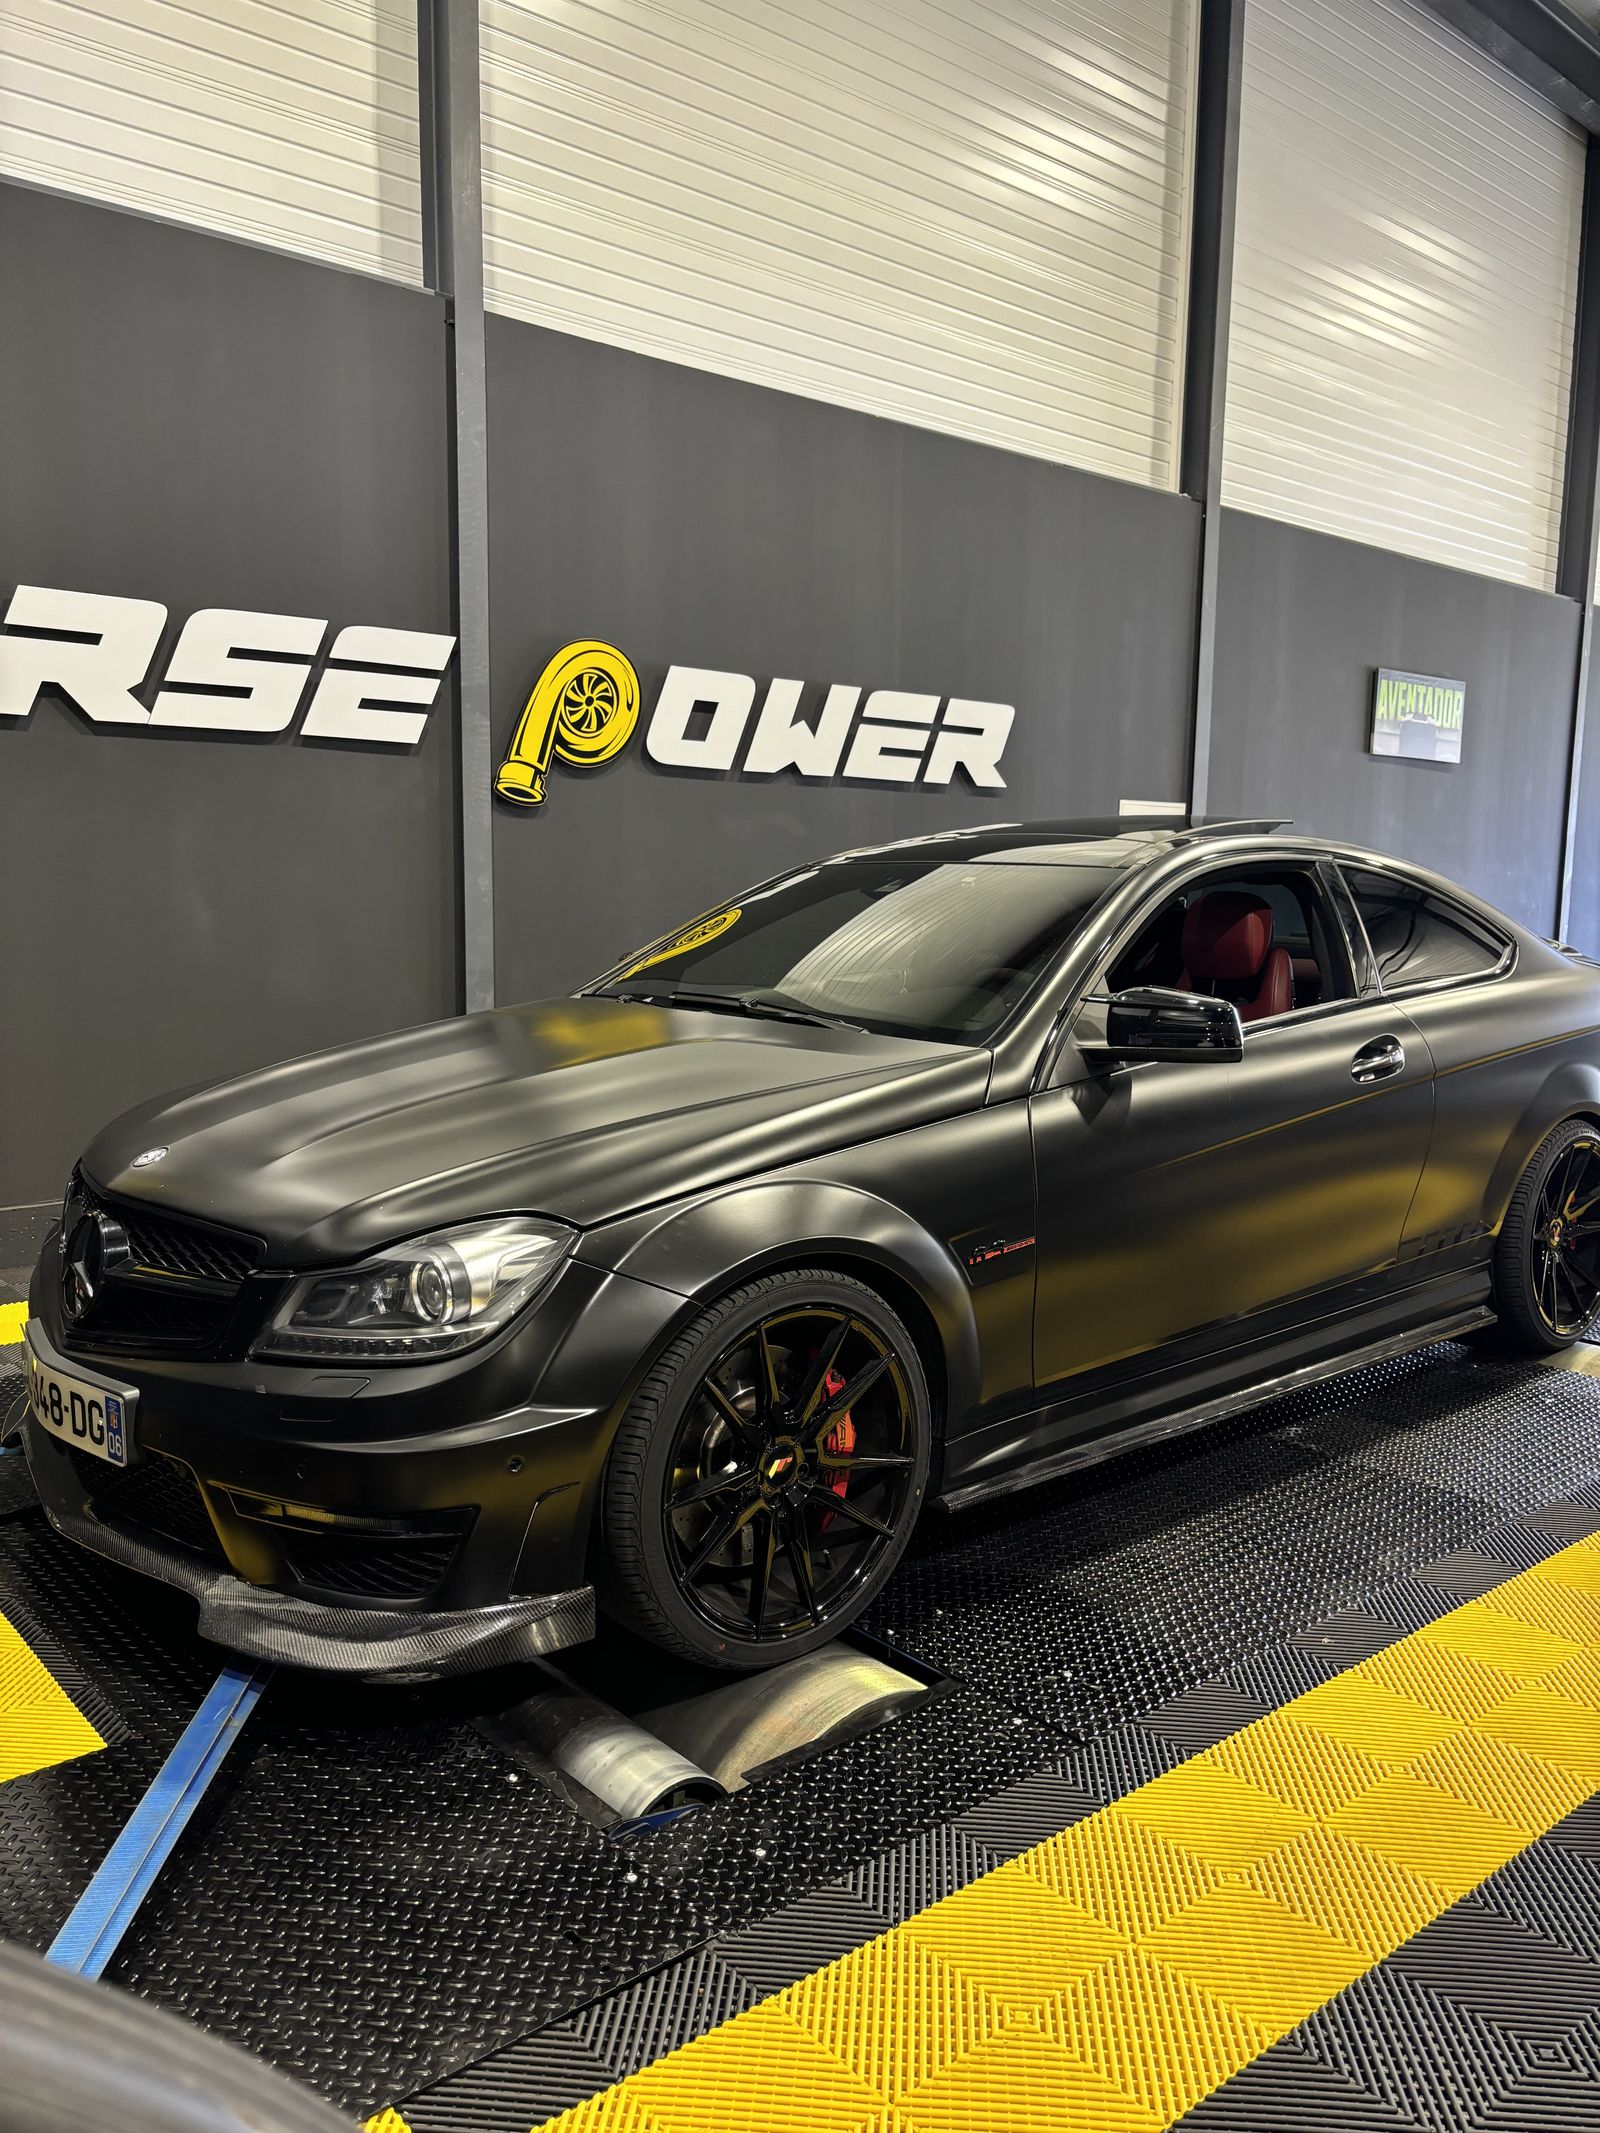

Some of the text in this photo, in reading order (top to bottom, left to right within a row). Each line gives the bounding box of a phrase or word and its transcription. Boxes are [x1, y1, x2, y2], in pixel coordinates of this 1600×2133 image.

[0, 584, 457, 744] RSE
[1377, 679, 1463, 730] AVENTADOR
[108, 1431, 122, 1457] 06
